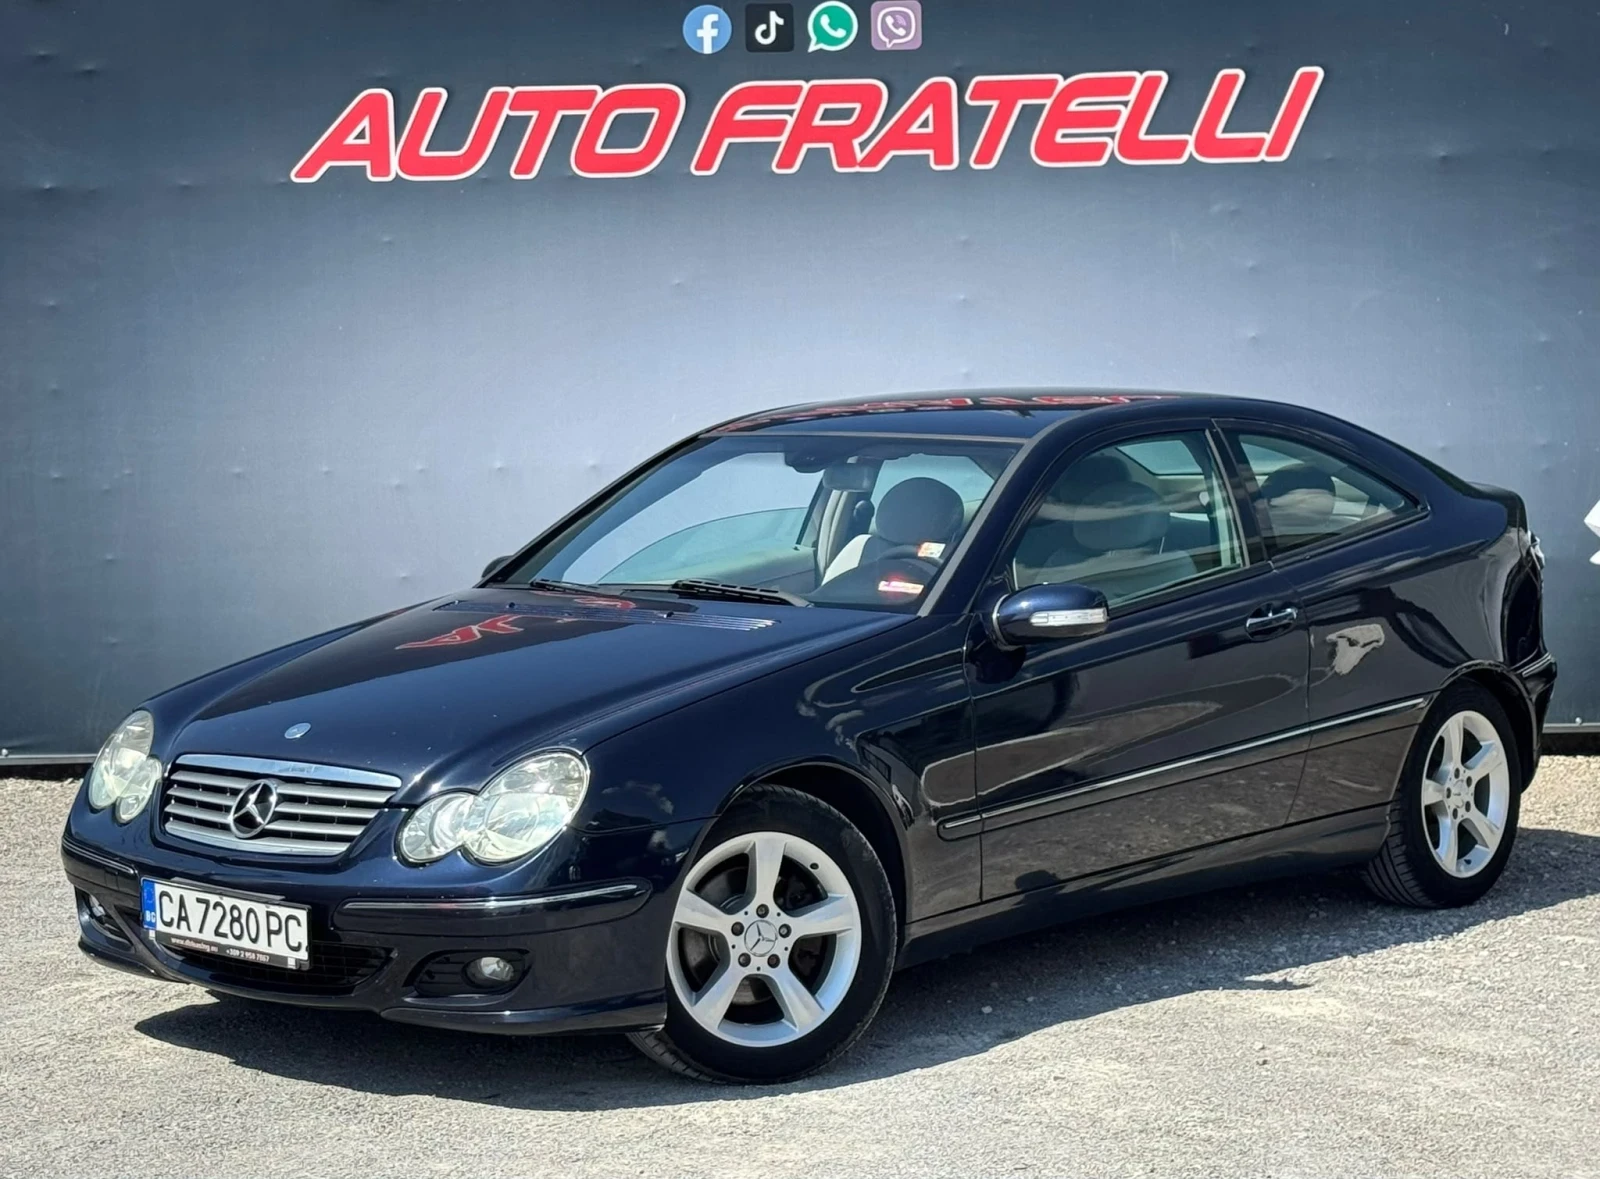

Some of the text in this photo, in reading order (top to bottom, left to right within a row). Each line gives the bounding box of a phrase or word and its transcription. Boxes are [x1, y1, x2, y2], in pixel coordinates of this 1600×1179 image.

[290, 66, 1325, 183] AUTO FRATELLI
[145, 910, 156, 923] BG
[158, 890, 302, 953] CA 7280 PC
